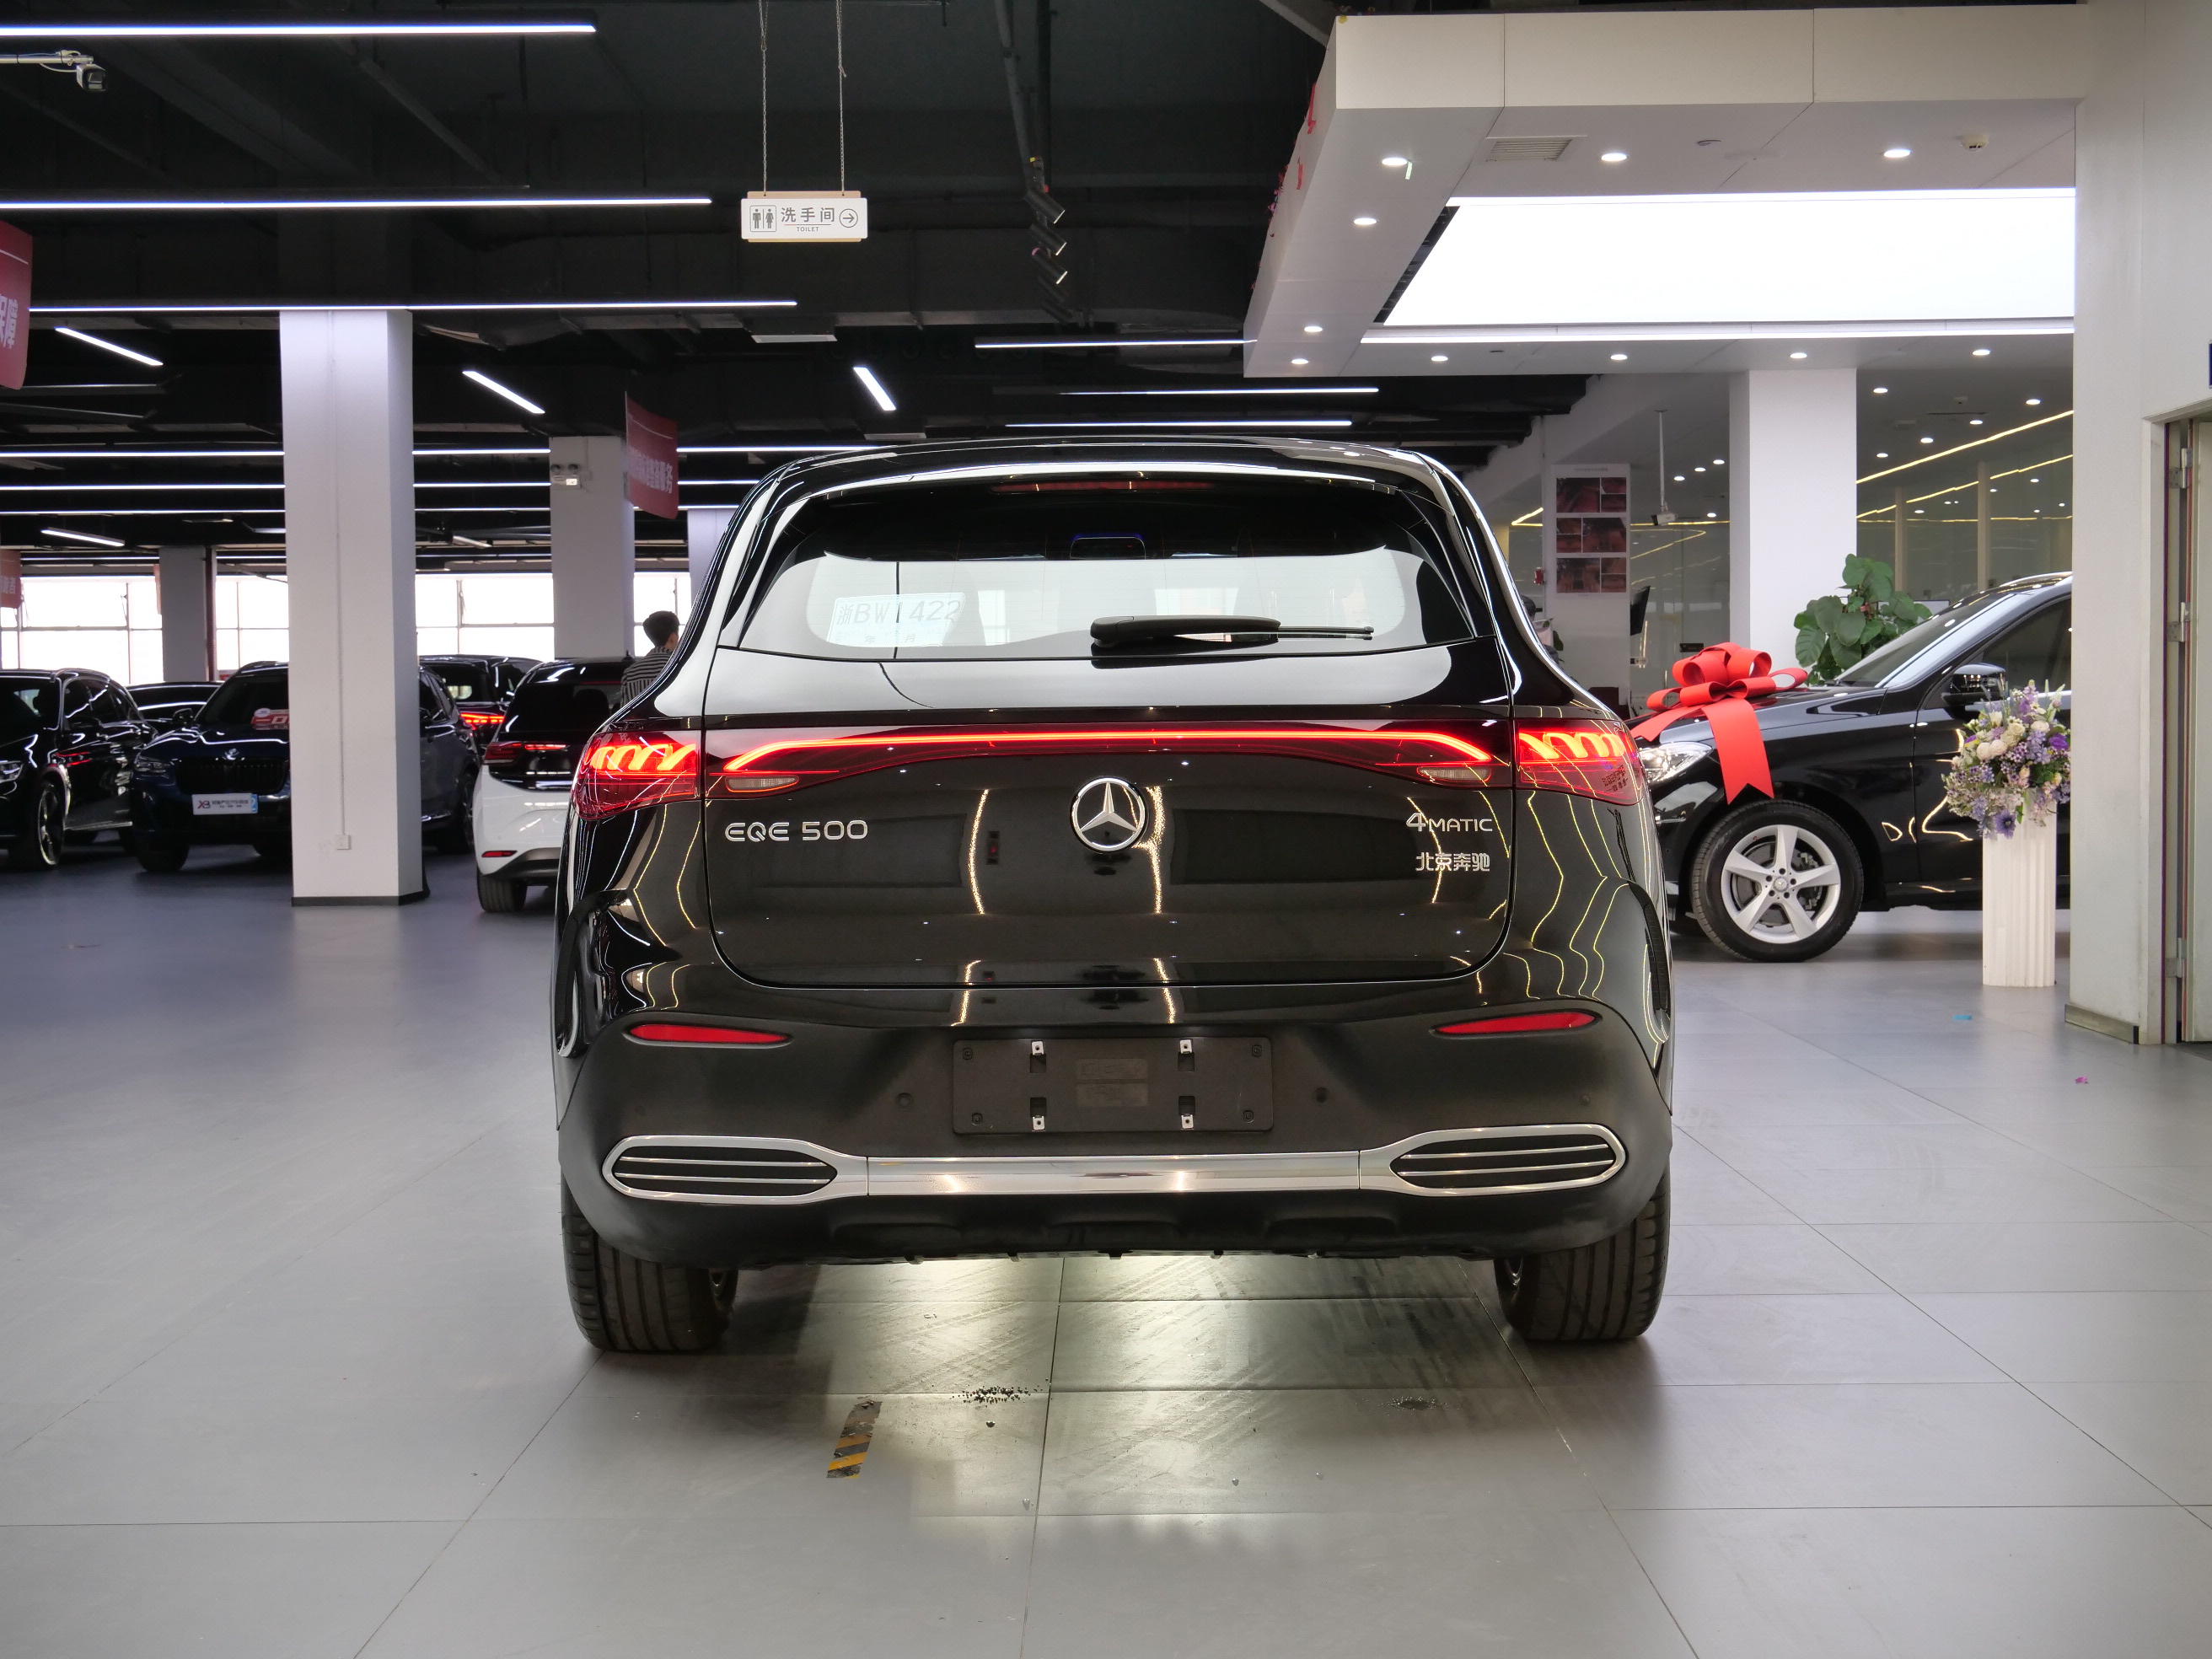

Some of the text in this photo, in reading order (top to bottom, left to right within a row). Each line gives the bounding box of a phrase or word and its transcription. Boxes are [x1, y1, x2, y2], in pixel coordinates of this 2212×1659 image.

[781, 207, 835, 223] 洗手间
[724, 819, 868, 842] EQE 500
[1405, 812, 1493, 832] 4MATIC
[1415, 851, 1490, 872] 北京奔驰
